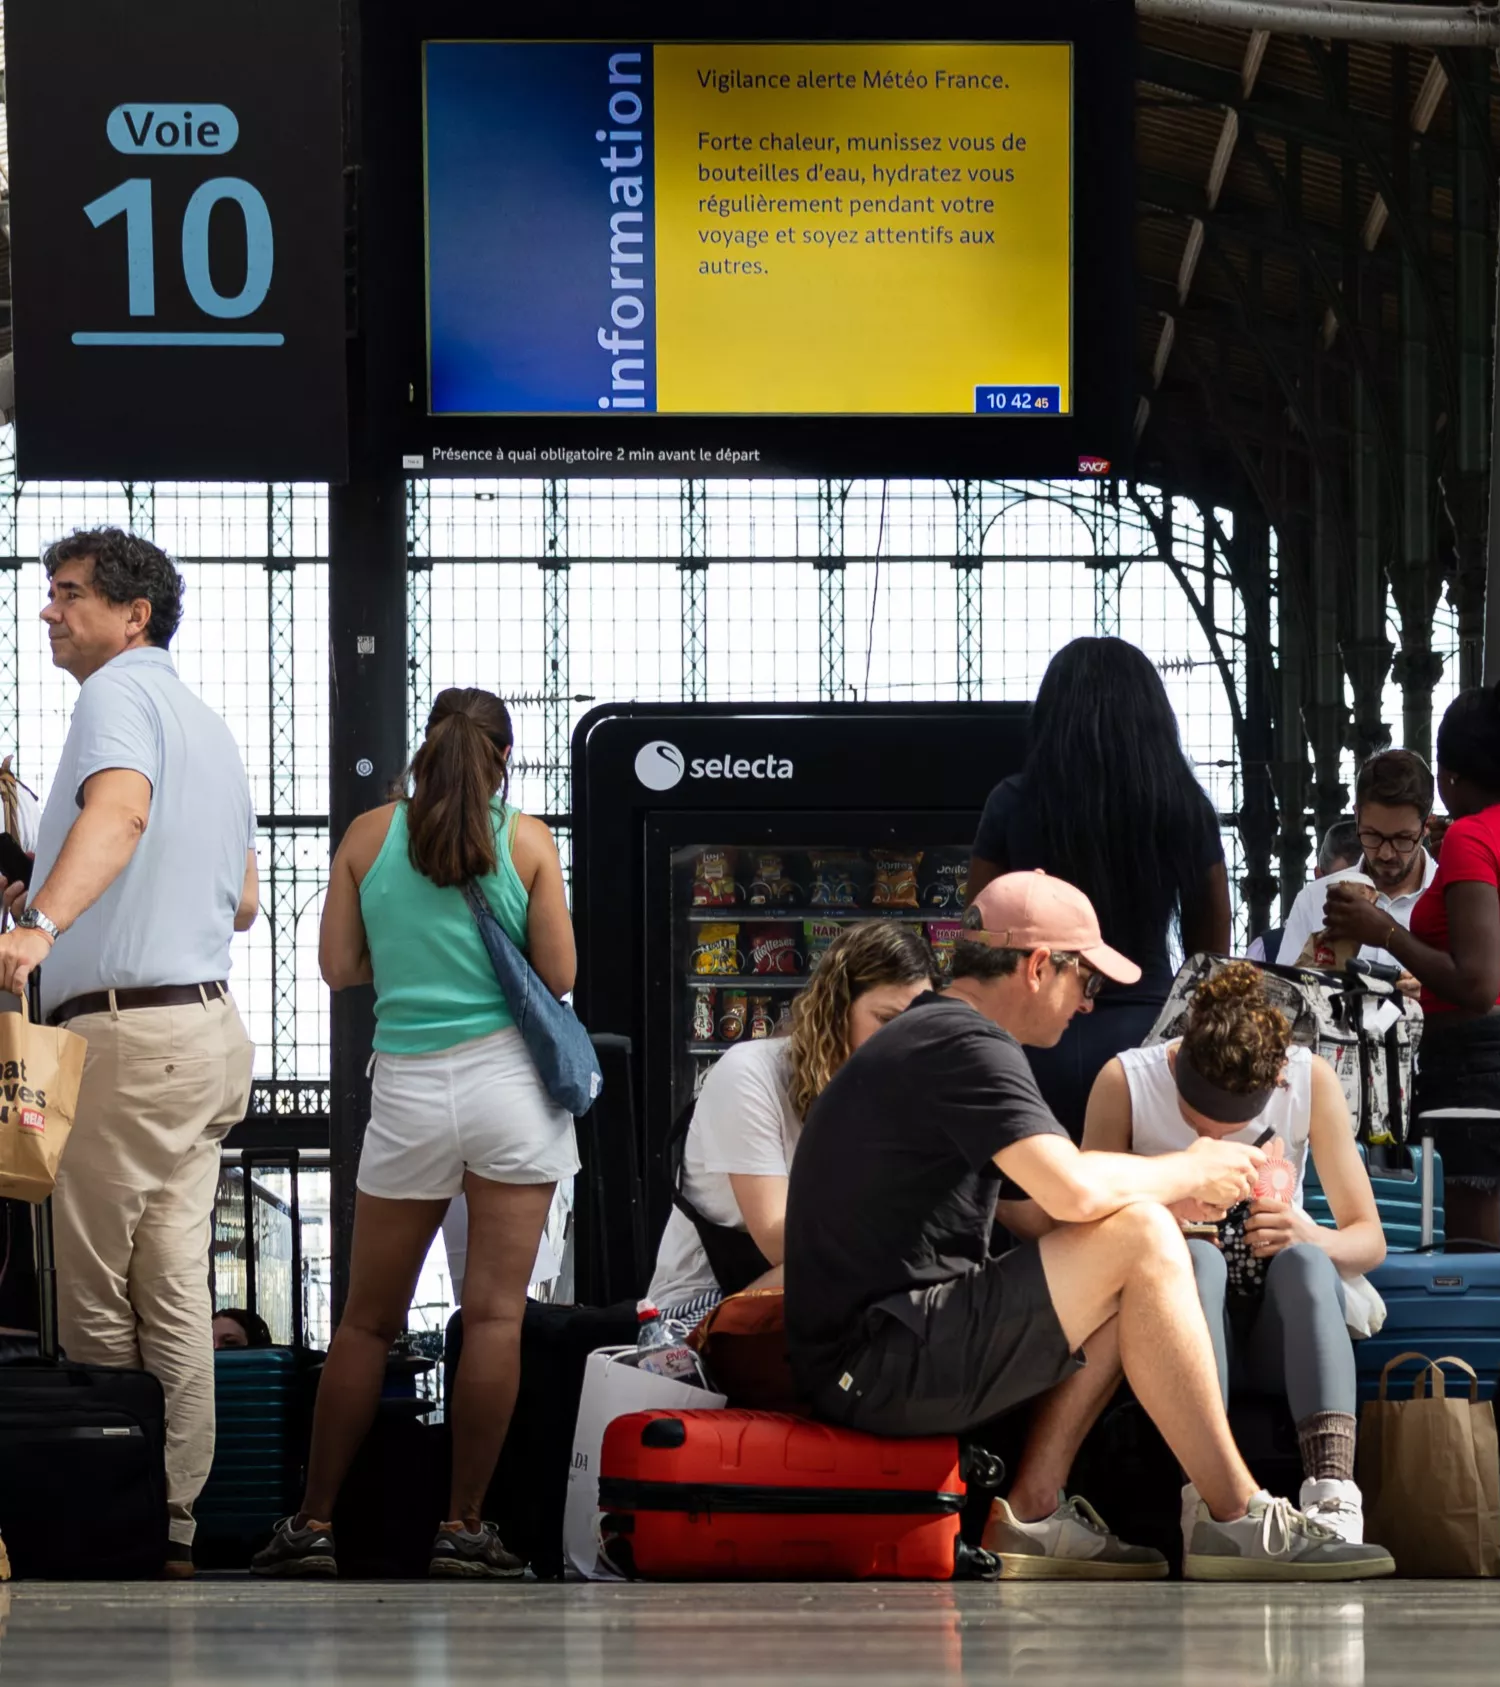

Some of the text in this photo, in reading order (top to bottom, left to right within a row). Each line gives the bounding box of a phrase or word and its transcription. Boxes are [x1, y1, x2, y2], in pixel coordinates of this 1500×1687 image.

[697, 69, 1009, 94] Vigilance alerte Météo France.
[122, 110, 220, 148] Voie
[698, 132, 1027, 154] Forte chaleur, munissez vous de
[698, 162, 1015, 187] bouteilles d'eau, hydratez vous
[699, 194, 995, 218] régulièrement pendant votre
[595, 52, 645, 408] information
[698, 225, 995, 249] voyage et soyez attentifs aux
[83, 177, 273, 319] 10
[698, 258, 768, 275] autres.
[987, 393, 1049, 409] 10 42 45
[432, 447, 760, 465] Présence à quai obligatoire 2 min avant le départ
[1079, 462, 1108, 472] SNCF
[689, 753, 794, 779] selecta
